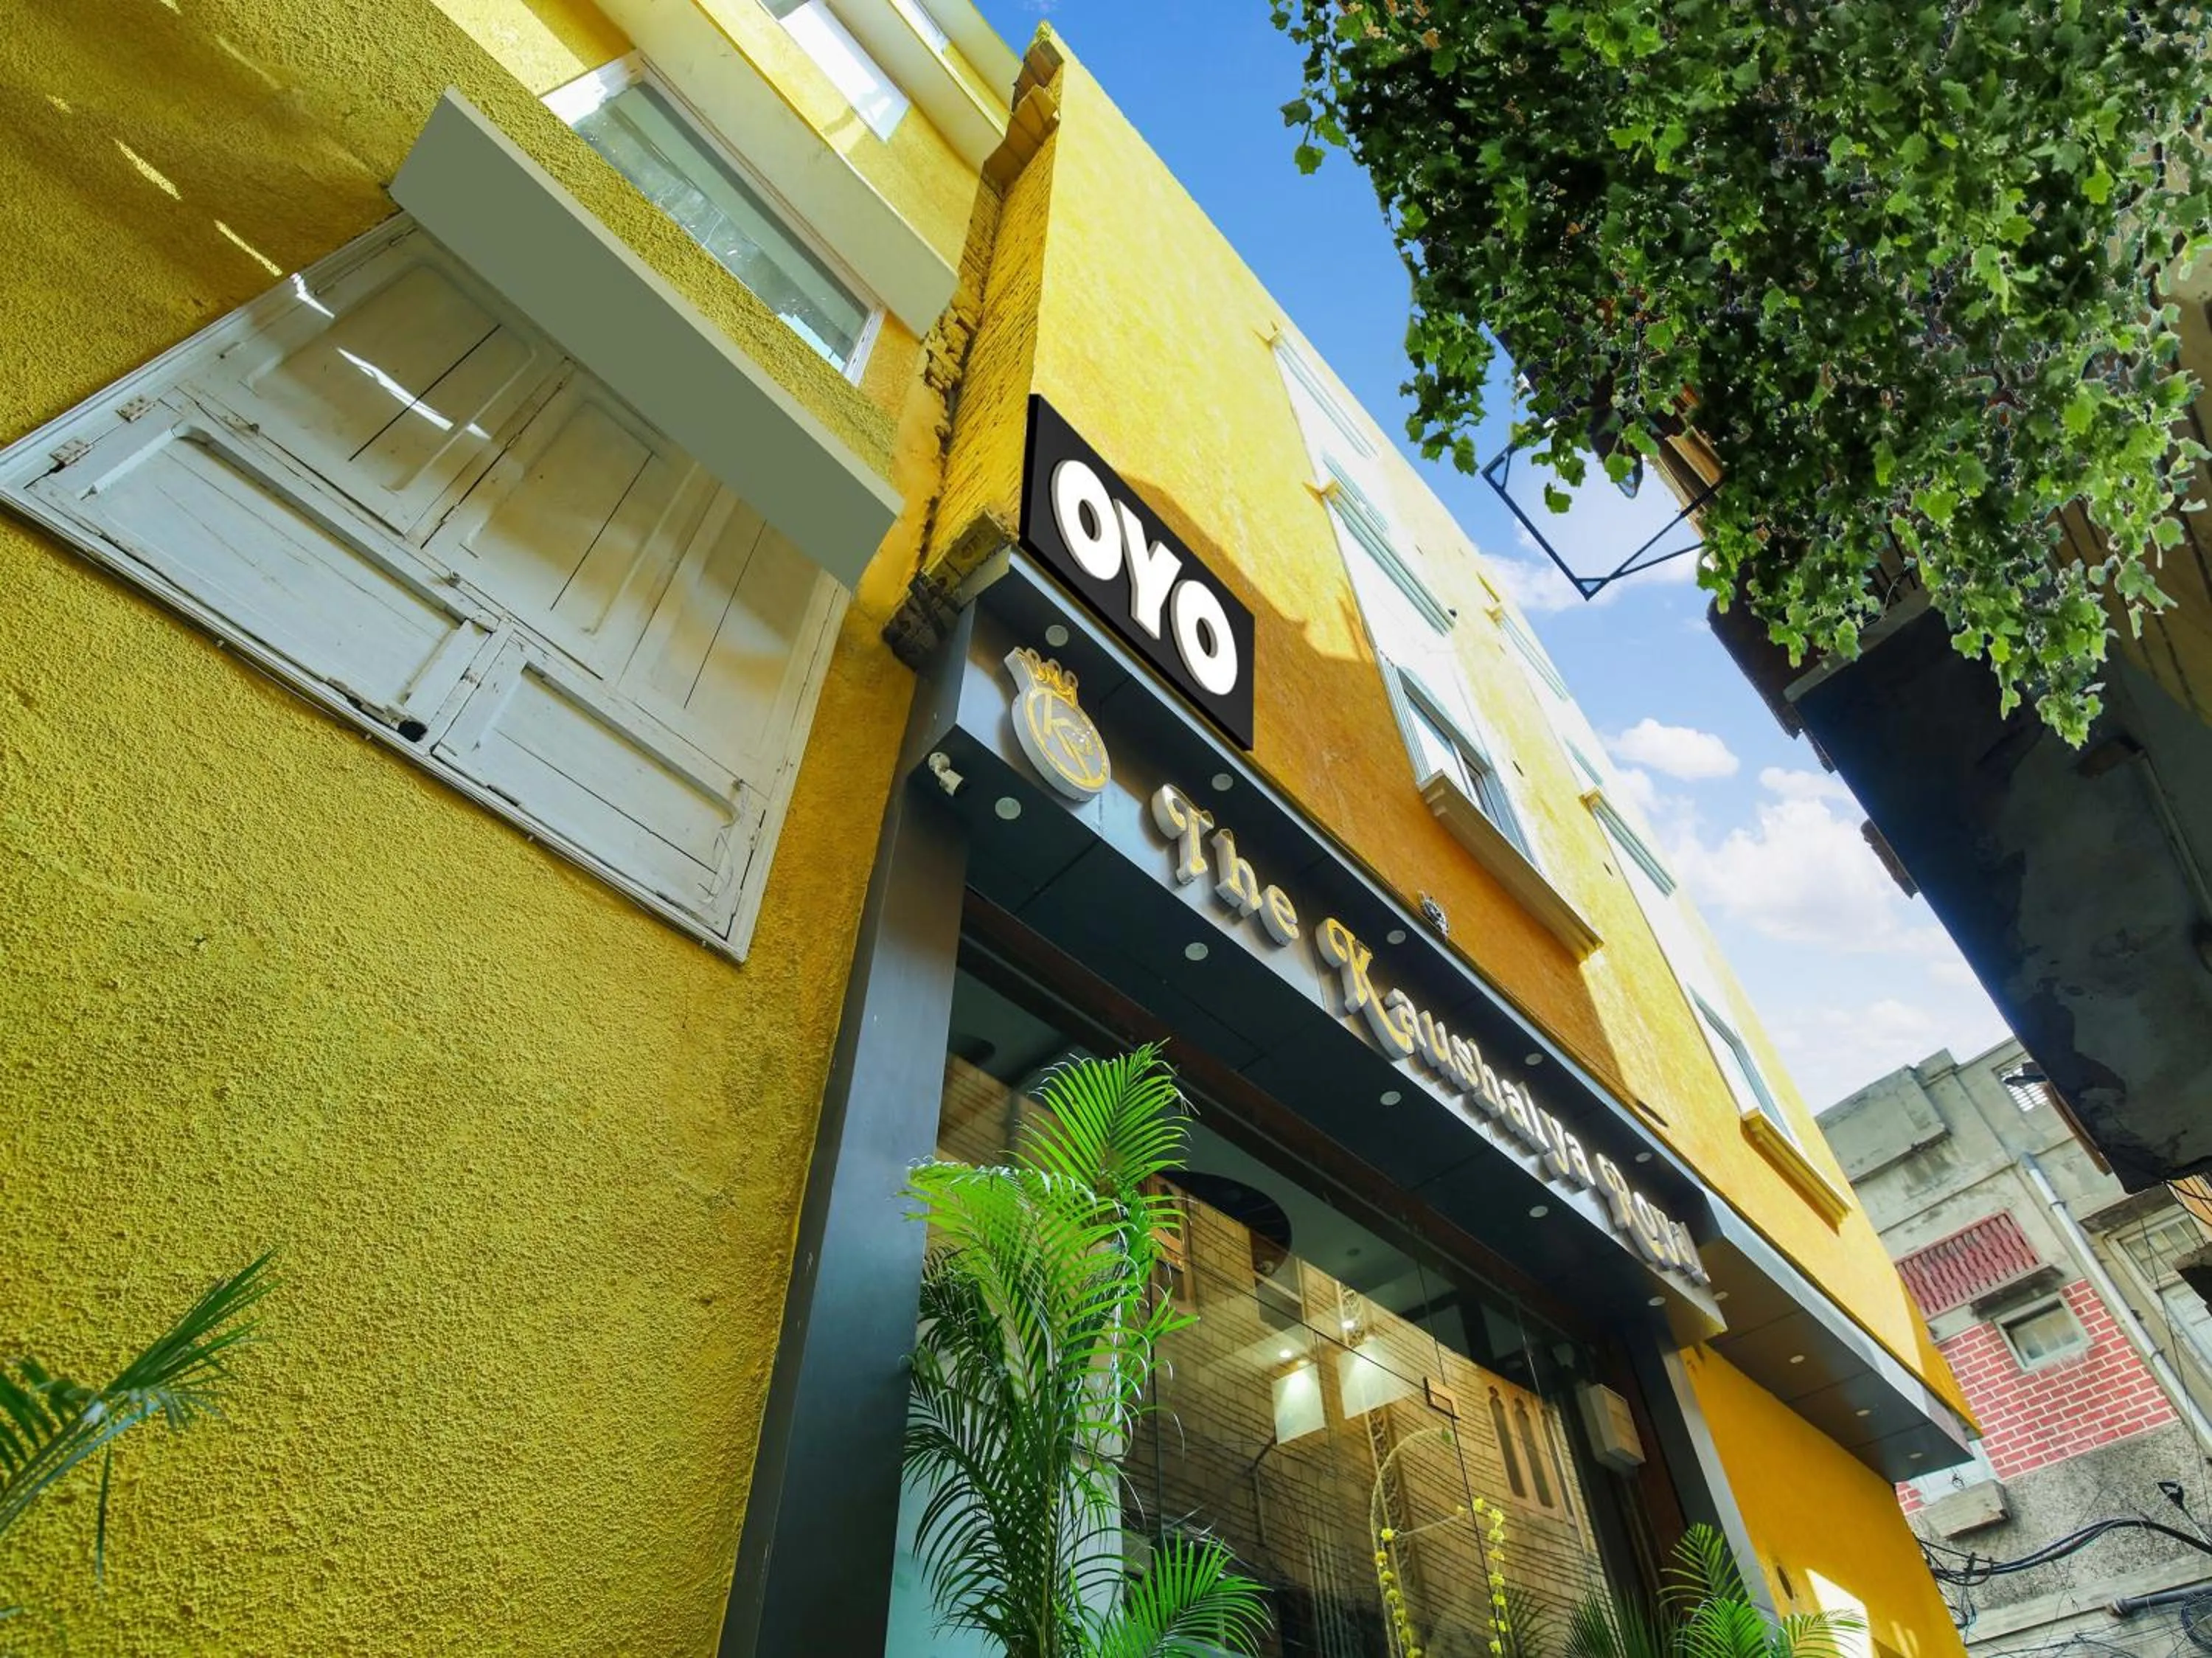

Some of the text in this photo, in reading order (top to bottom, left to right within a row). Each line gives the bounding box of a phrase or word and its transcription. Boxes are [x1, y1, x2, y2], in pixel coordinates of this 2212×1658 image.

[1050, 459, 1238, 696] OYO
[1152, 783, 1712, 1286] The Kaushalya Royal
